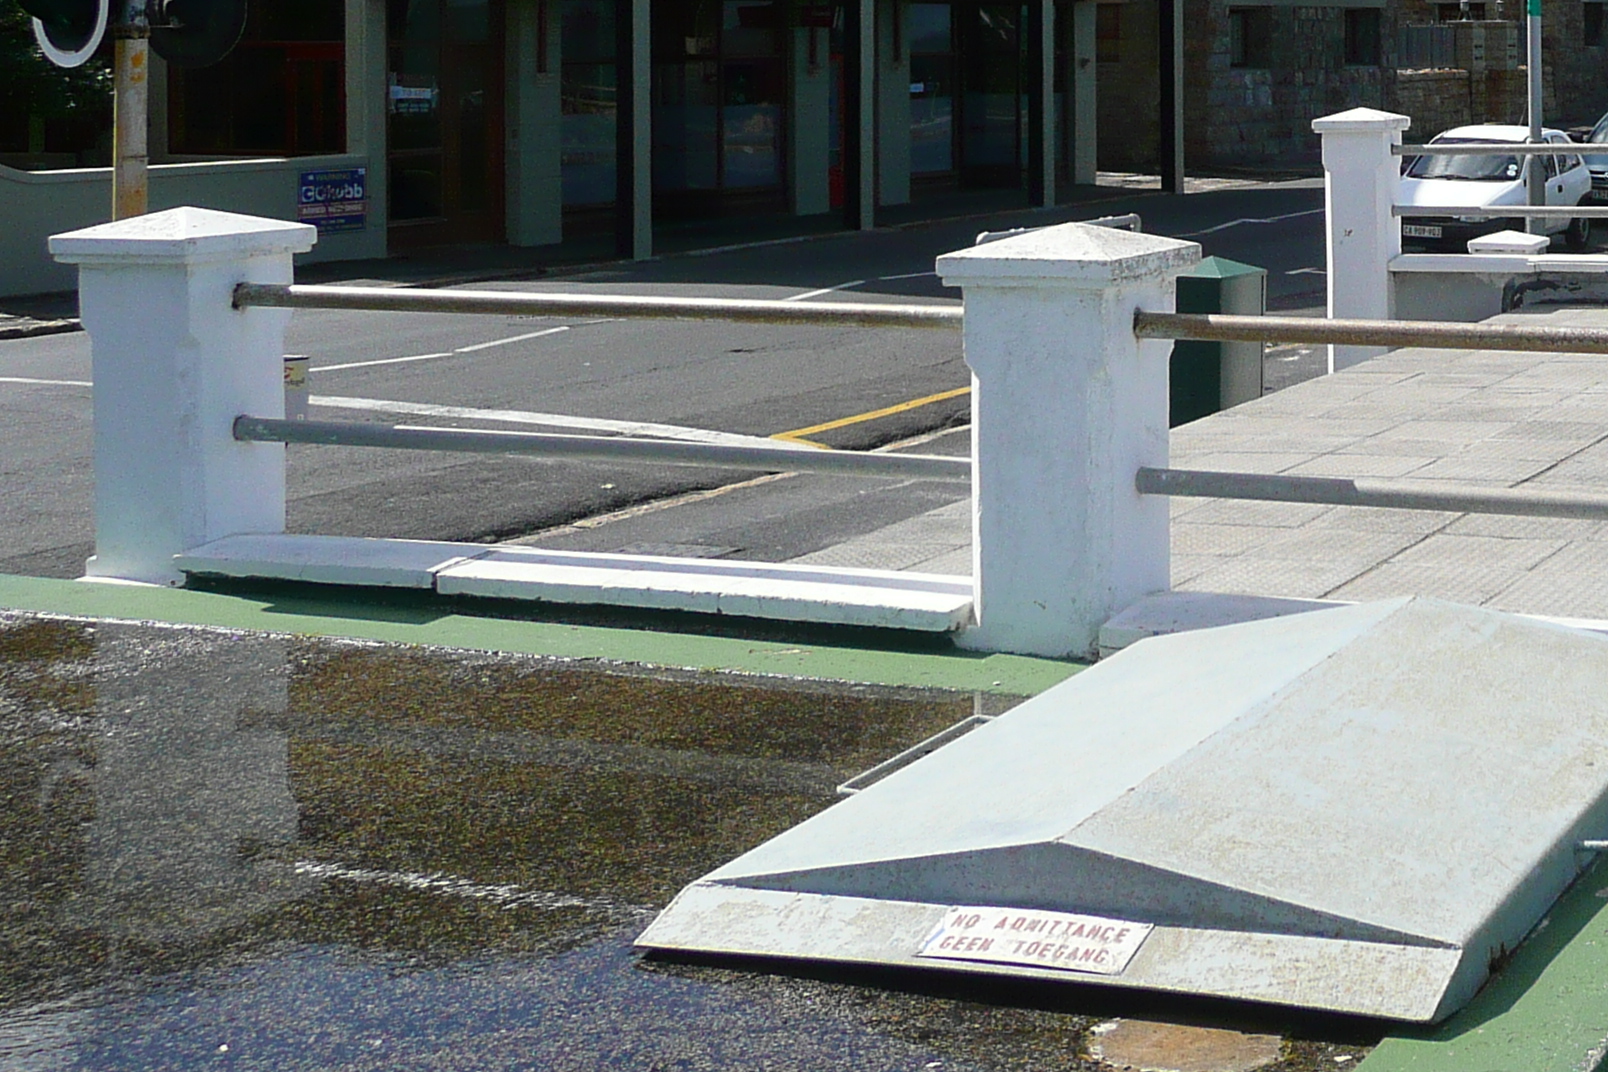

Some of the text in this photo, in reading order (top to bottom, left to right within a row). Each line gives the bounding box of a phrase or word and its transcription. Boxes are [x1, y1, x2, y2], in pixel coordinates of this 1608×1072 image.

[951, 913, 1131, 943] NO ADMITTANCE
[939, 935, 1109, 964] GEEN TOEGANG
